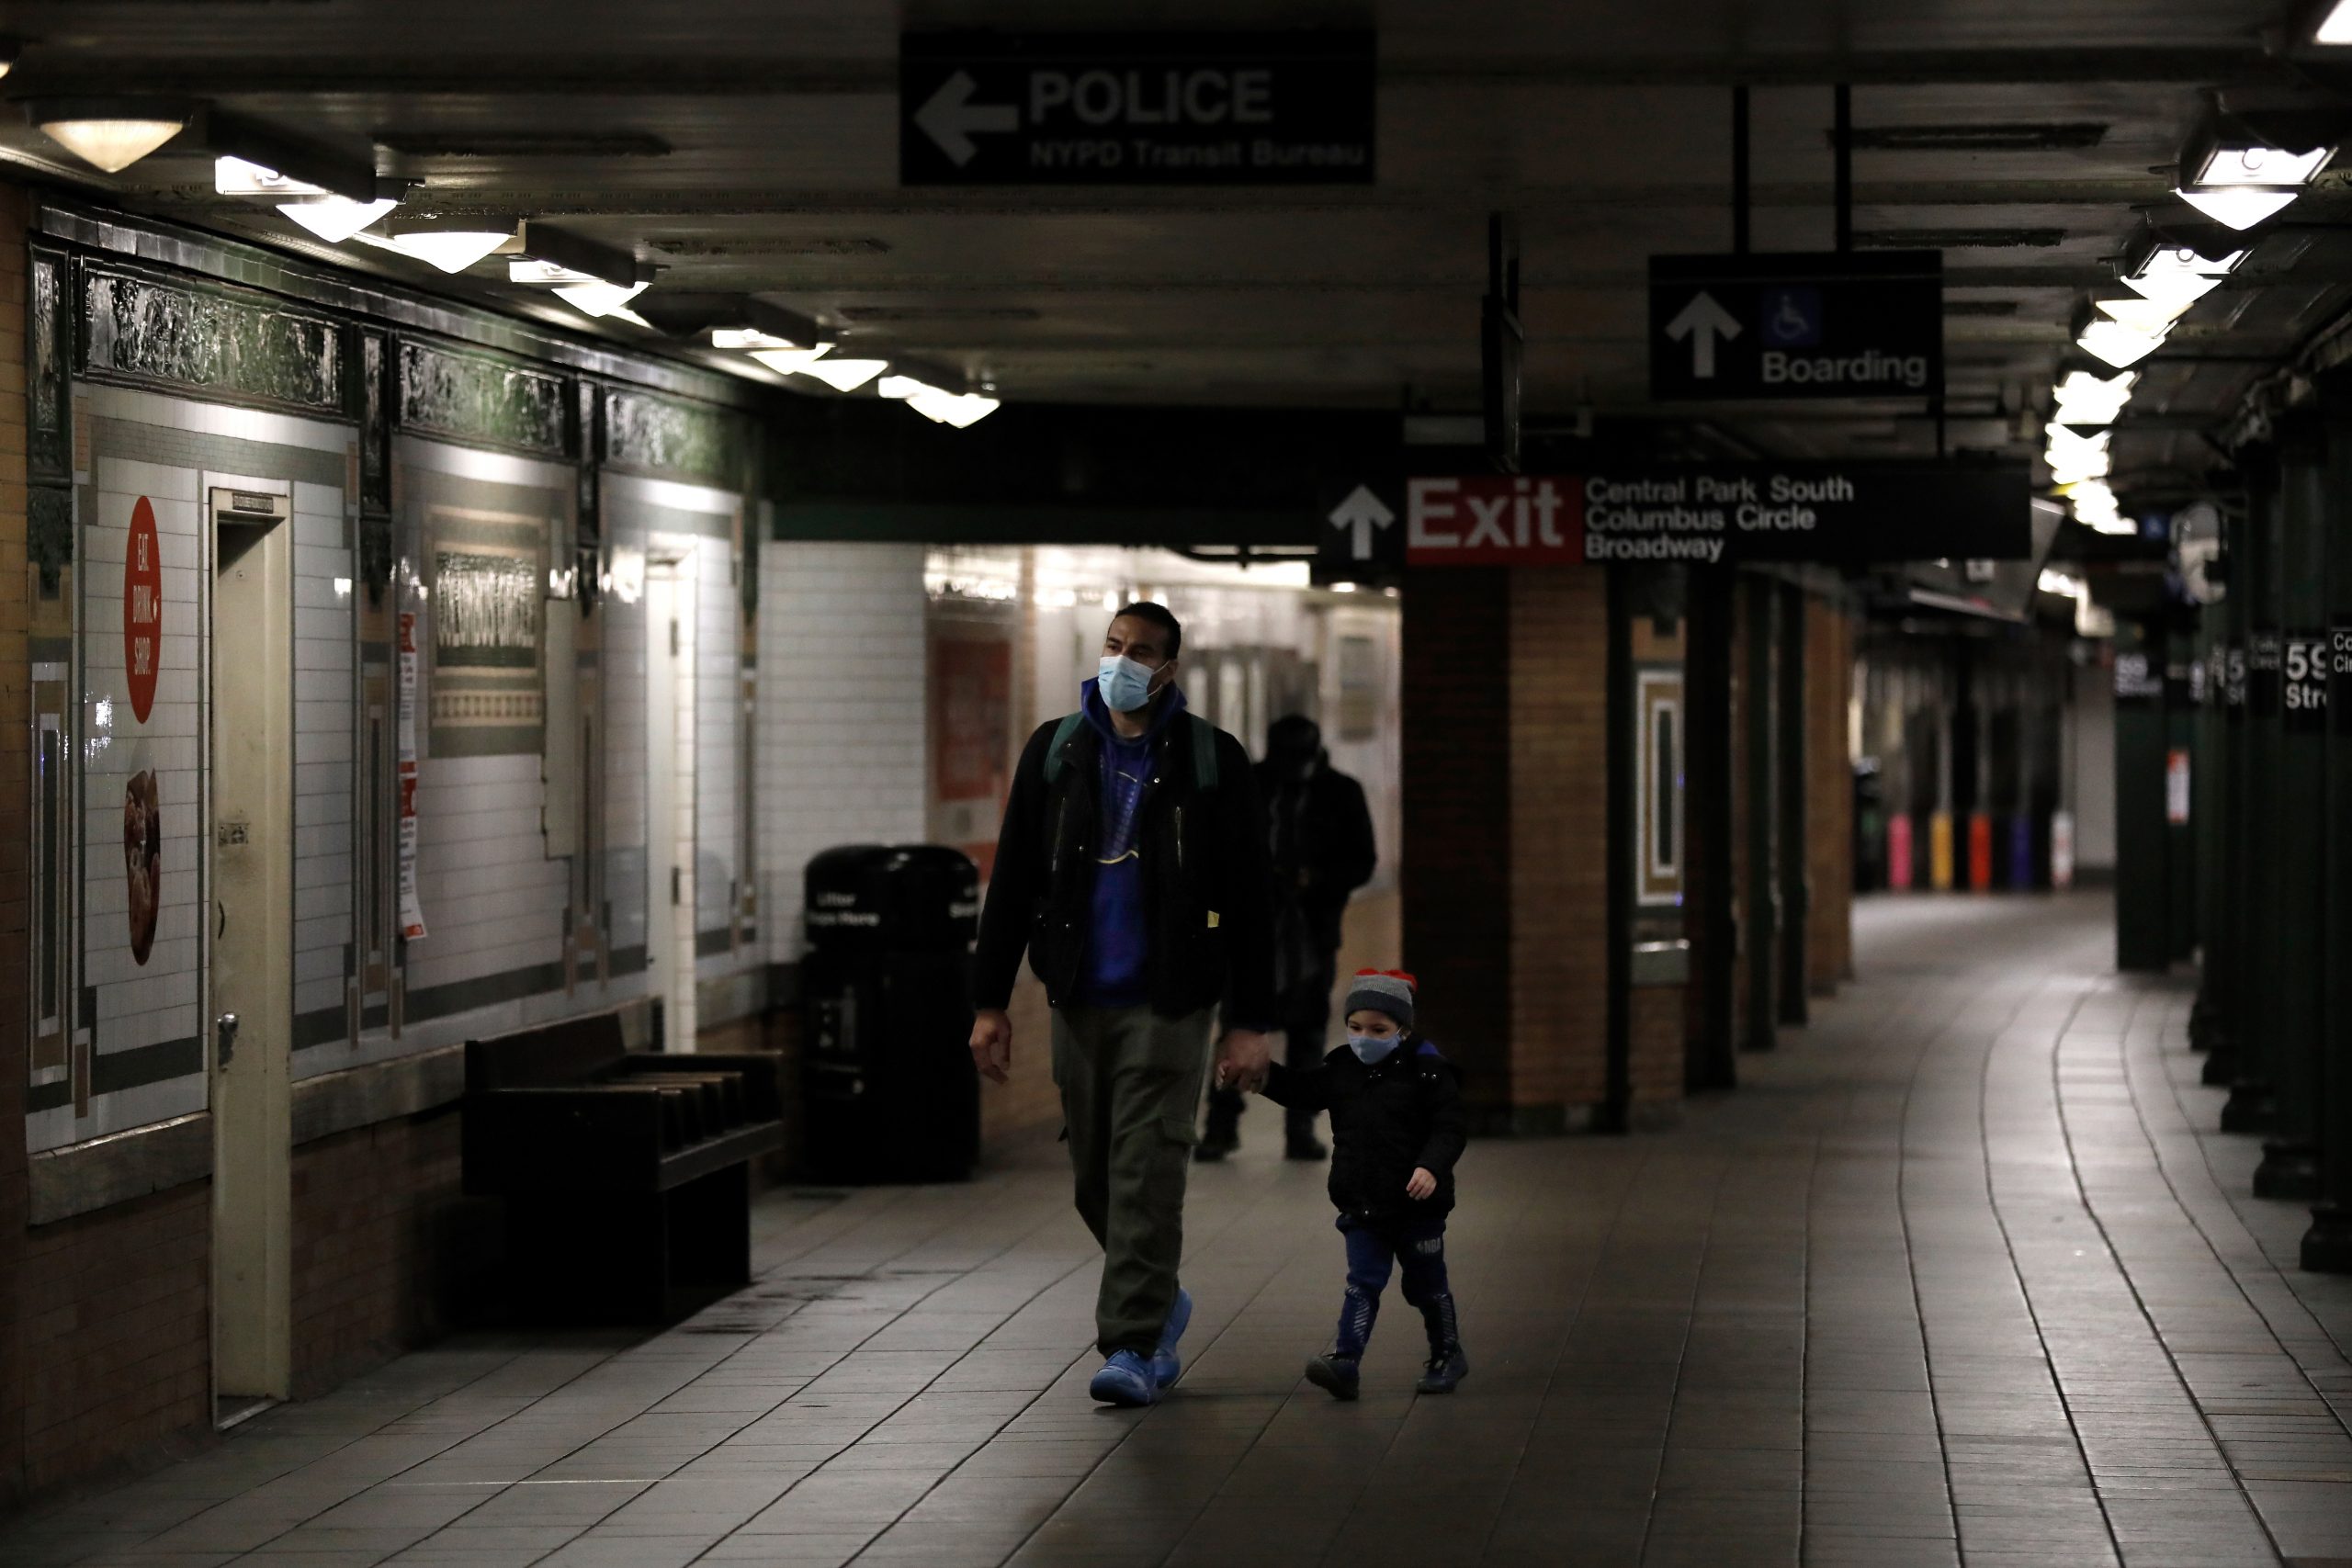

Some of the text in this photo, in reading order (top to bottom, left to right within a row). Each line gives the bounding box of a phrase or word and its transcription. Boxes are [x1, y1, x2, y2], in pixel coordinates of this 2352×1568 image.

[1029, 69, 1275, 127] POLICE
[1029, 139, 1366, 168] NYPD Transit Bureau
[1760, 349, 1928, 388] Boarding
[1584, 474, 1855, 503] Central Park South
[1407, 477, 1566, 548] Exit
[1584, 502, 1817, 532] Columbus Circle
[1584, 533, 1725, 564] Broadway
